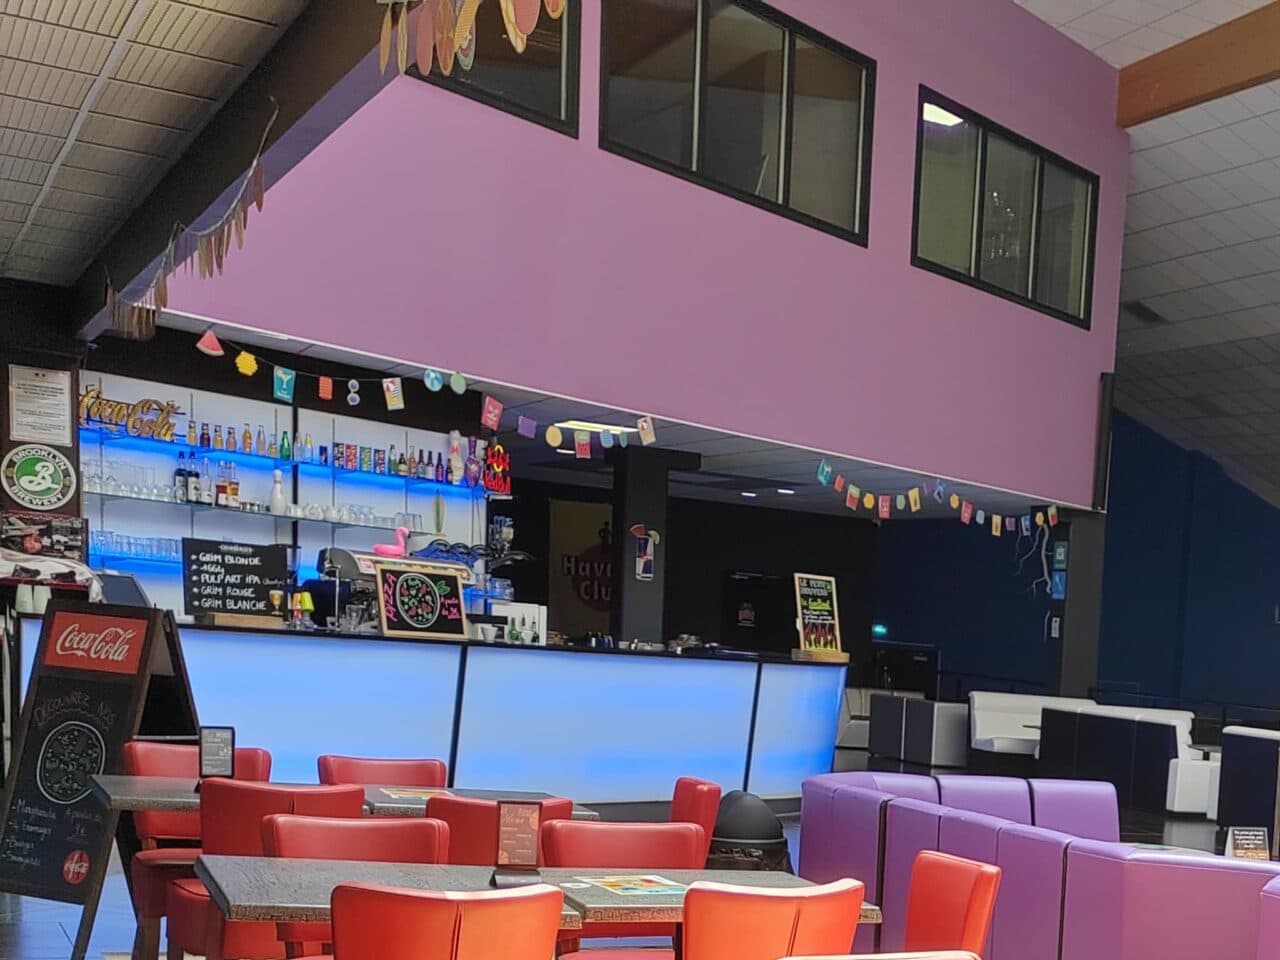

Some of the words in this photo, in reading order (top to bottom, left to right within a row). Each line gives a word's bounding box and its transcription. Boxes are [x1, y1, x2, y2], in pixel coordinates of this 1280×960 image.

[12, 449, 66, 471] BROOKLYN
[10, 486, 65, 506] BREWERY
[224, 555, 262, 566] BLONDE
[226, 587, 256, 598] ROUGE
[384, 572, 398, 622] PIZZA
[580, 580, 611, 601] Clu
[226, 599, 267, 611] BLANCHE
